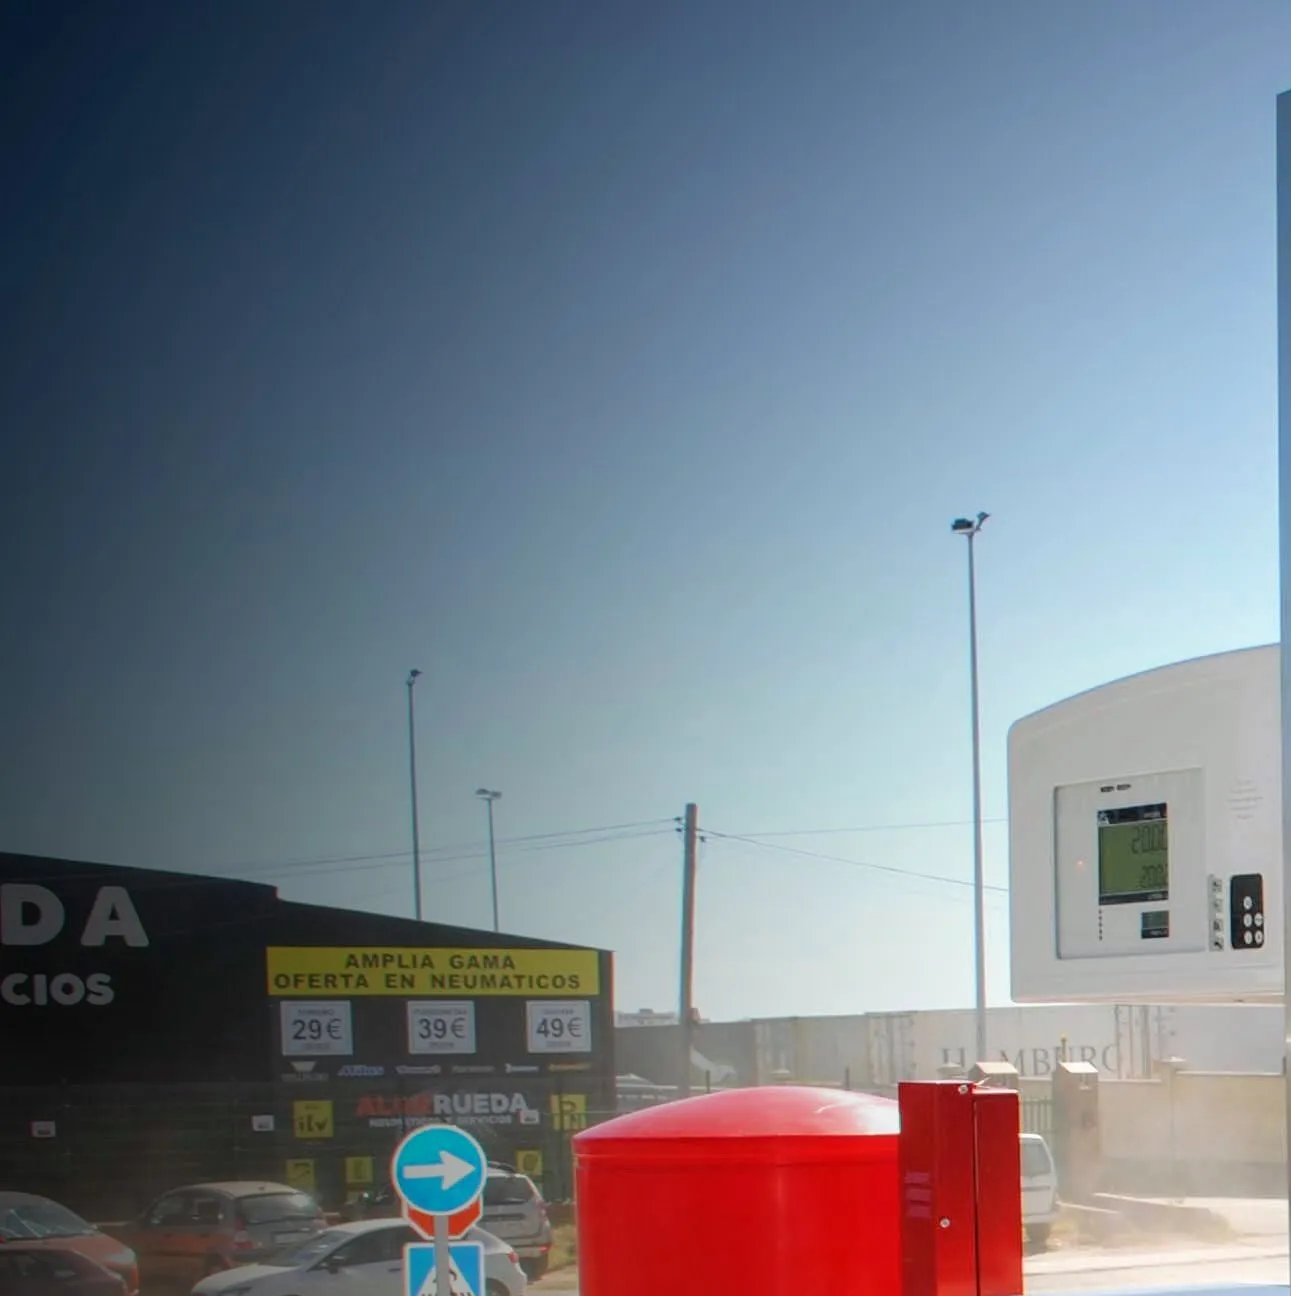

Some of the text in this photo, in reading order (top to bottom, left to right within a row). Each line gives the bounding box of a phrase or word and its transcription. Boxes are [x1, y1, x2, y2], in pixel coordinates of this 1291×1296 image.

[345, 953, 516, 970] AMPLIA GAMA
[274, 973, 581, 990] OFERTA EN NEUMATICOS
